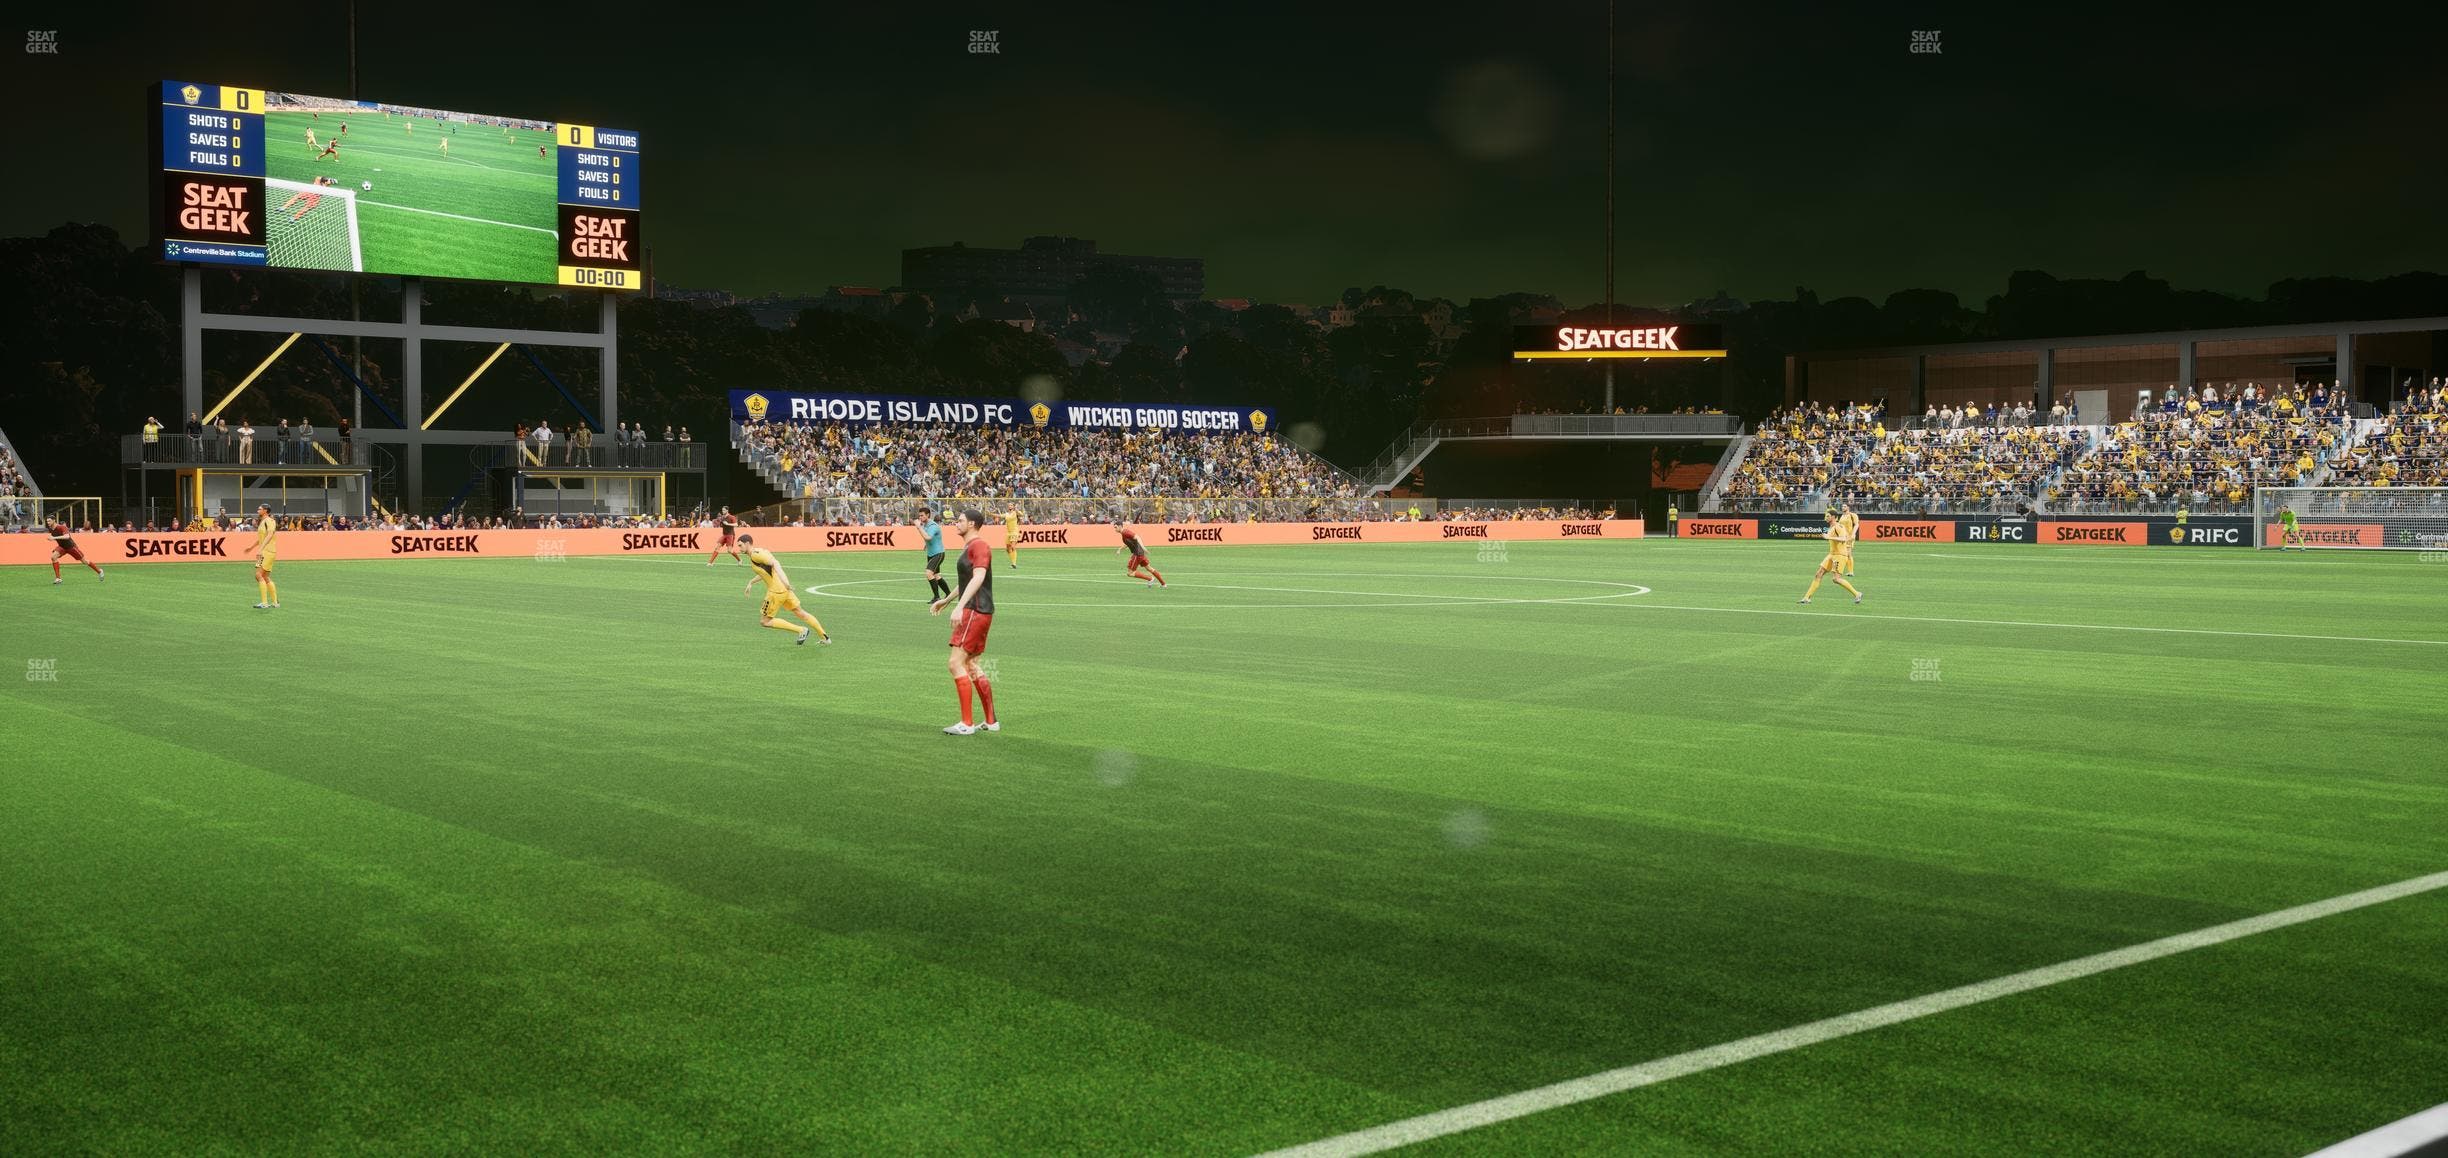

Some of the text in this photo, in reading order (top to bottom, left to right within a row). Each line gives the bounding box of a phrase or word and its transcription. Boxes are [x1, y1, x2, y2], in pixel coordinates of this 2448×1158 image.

[237, 90, 249, 110] 0
[189, 114, 240, 130] SHOTS 0
[190, 133, 240, 148] SAVES 0
[571, 127, 636, 147] 0 VISITORS
[190, 152, 240, 167] FOULS 0
[578, 154, 620, 168] SHOTS 0
[578, 171, 620, 184] SAVES 0
[184, 182, 248, 208] SEAT
[579, 187, 620, 200] FOULS 0
[180, 208, 250, 234] GEEK
[574, 214, 626, 238] SEAT
[238, 250, 264, 258] Stadium
[572, 238, 628, 262] GEEK
[576, 268, 624, 286] 00:00
[1558, 326, 1679, 350] SEATGEEK
[791, 398, 1013, 424] RHODE ISLAND FC
[1068, 406, 1239, 430] WICKED GOOD SOCCER
[1017, 529, 1067, 544] EATGEEK
[1168, 528, 1222, 542] SEATGEEK
[1312, 526, 1361, 540] SEATGEEK
[1444, 525, 1488, 538] SEATGEEK
[1562, 524, 1602, 536] SEATGEEK
[1690, 523, 1742, 536] SEATGEEK
[1876, 525, 1936, 540] SEATGEEK
[2056, 526, 2126, 542] SEATGEEK
[2191, 528, 2238, 544] RIFC
[126, 537, 226, 557] SEATGEEK
[391, 535, 479, 553] SEATGEEK
[623, 532, 699, 550] SEATGEEK
[827, 531, 894, 547] SEATGEEK
